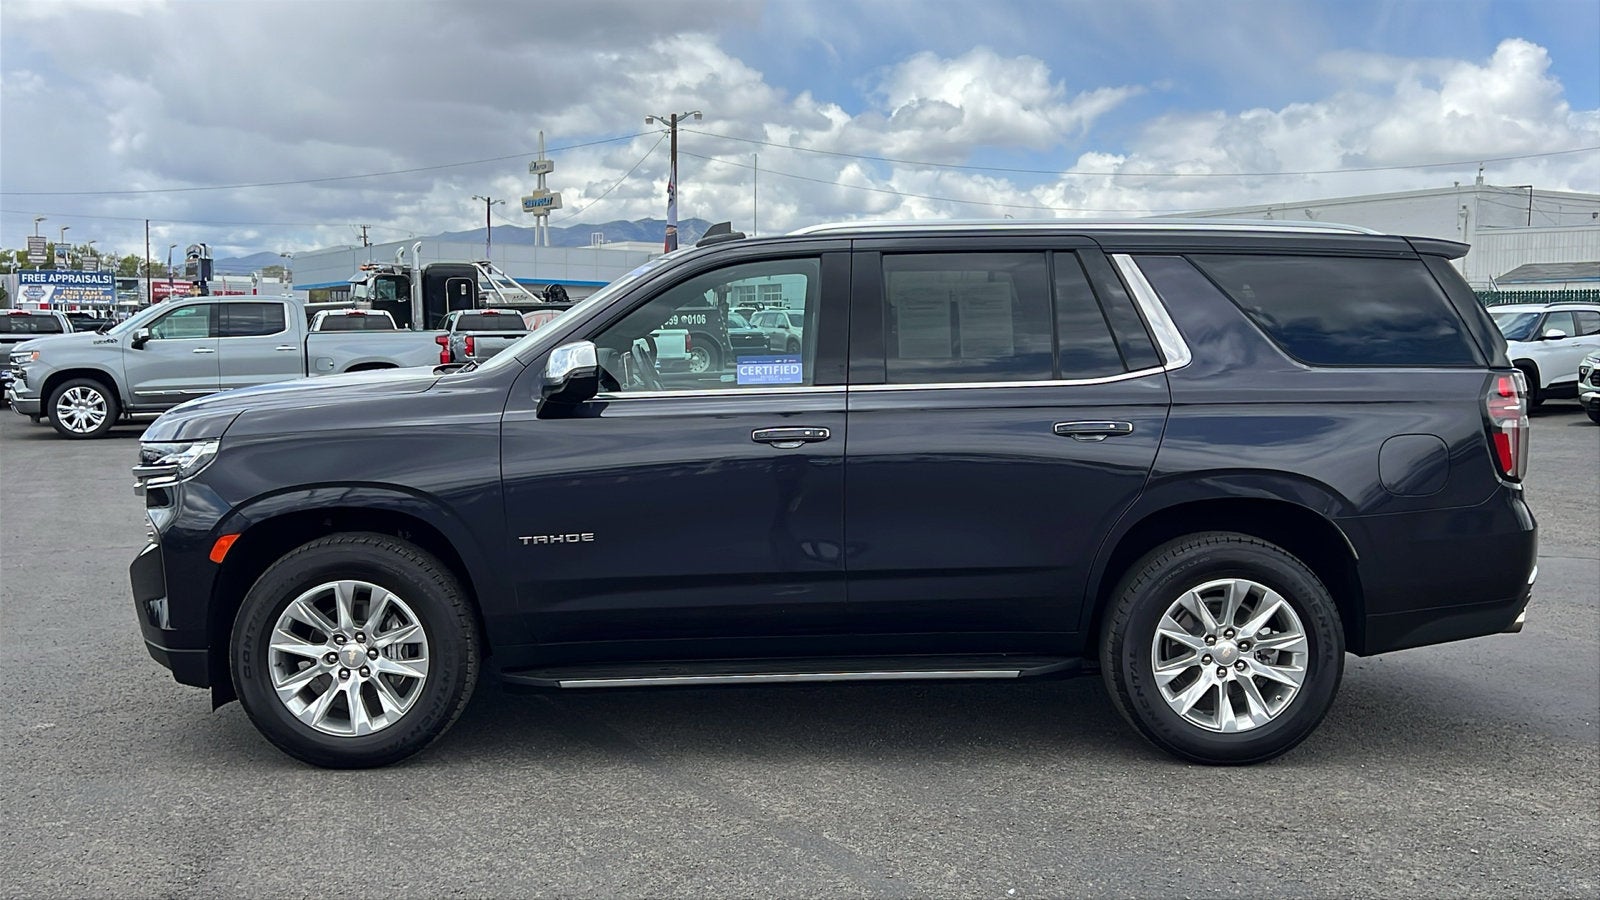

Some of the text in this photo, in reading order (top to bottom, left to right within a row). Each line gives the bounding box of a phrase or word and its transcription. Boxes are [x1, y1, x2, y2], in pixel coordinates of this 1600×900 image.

[21, 273, 112, 284] FREE APPRAISALS!
[687, 314, 706, 325] 0106
[740, 365, 799, 376] CERTIFIED
[518, 532, 595, 545] TAHOE
